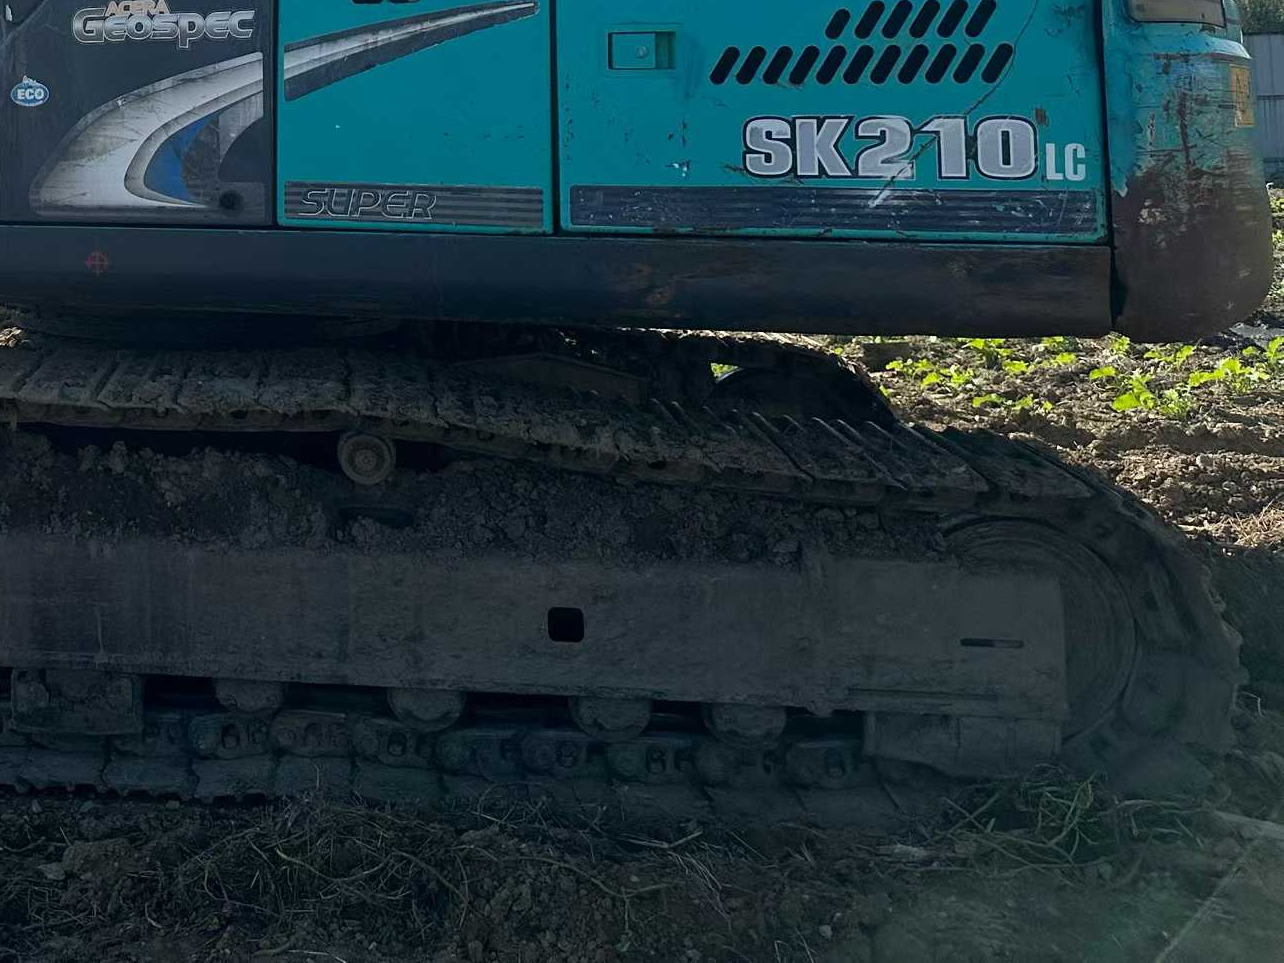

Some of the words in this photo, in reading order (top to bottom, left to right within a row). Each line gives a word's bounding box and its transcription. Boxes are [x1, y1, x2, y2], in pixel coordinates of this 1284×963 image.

[17, 88, 44, 100] ECO
[742, 115, 1040, 181] SK210
[1045, 143, 1086, 181] LC
[298, 188, 436, 220] SUPER
